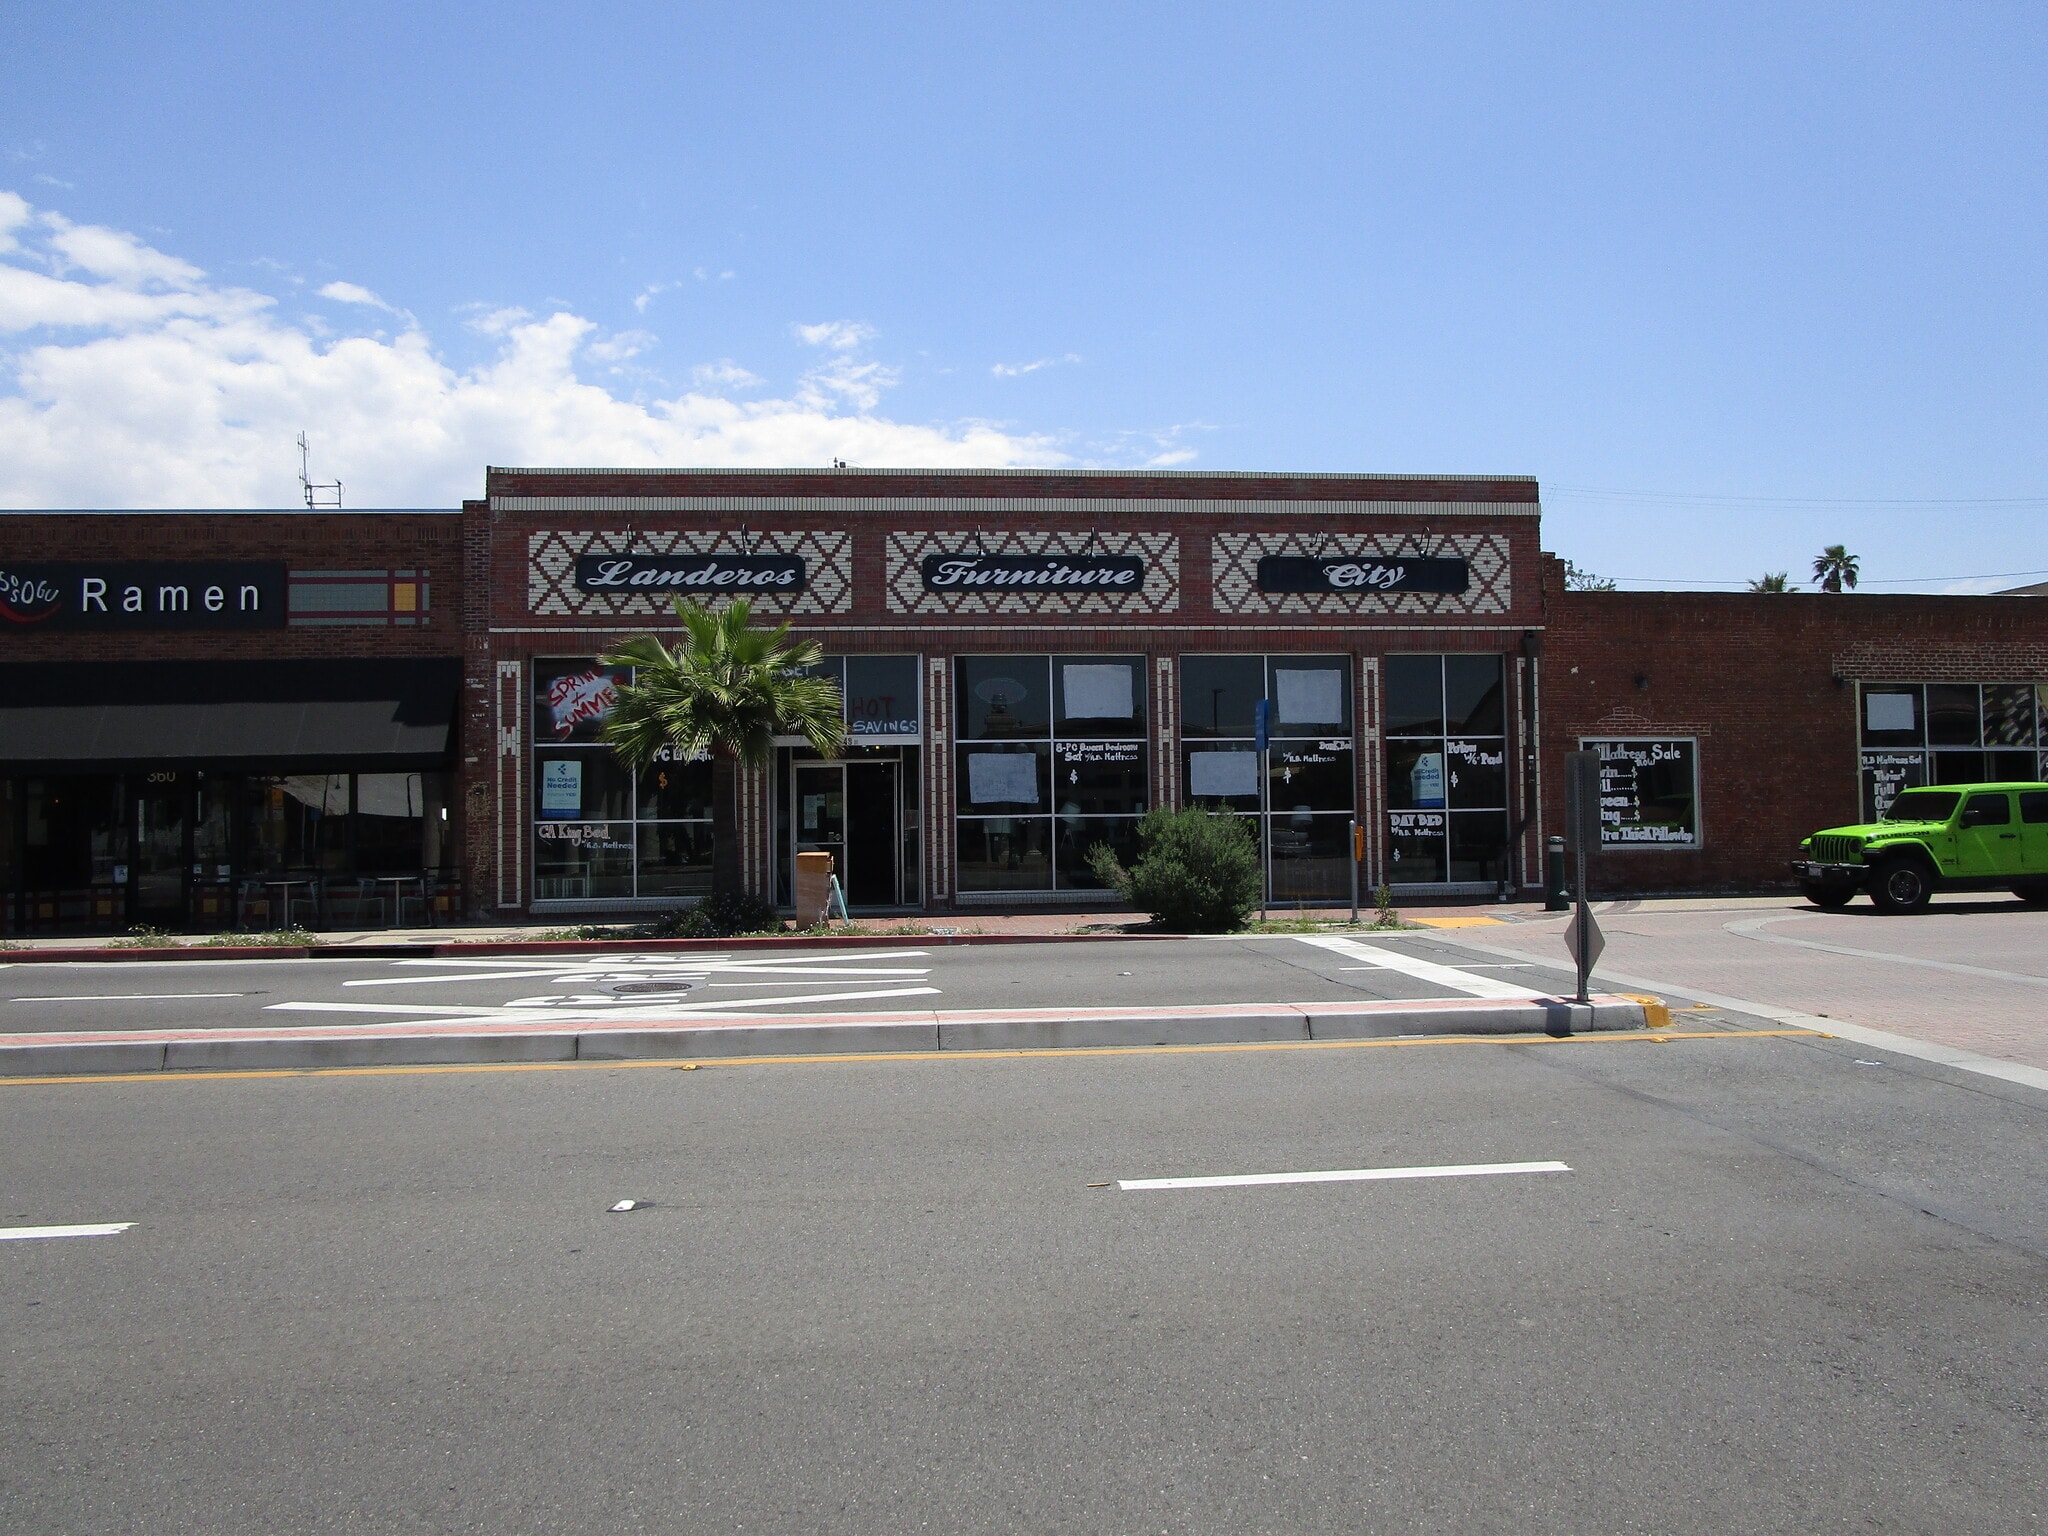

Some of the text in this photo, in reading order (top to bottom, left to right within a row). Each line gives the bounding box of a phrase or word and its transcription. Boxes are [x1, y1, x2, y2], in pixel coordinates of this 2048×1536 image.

[585, 560, 797, 587] Landeros
[931, 560, 1136, 586] Furniture
[1321, 562, 1407, 591] City
[82, 577, 259, 612] Ramen
[852, 696, 895, 718] HOT
[852, 720, 918, 734] SAVINGS
[1055, 742, 1078, 753] 8-PC
[1651, 743, 1681, 761] Sale
[1480, 751, 1503, 766] Pad
[1390, 814, 1443, 827] DAY BED
[1877, 831, 1930, 839] RUBICON
